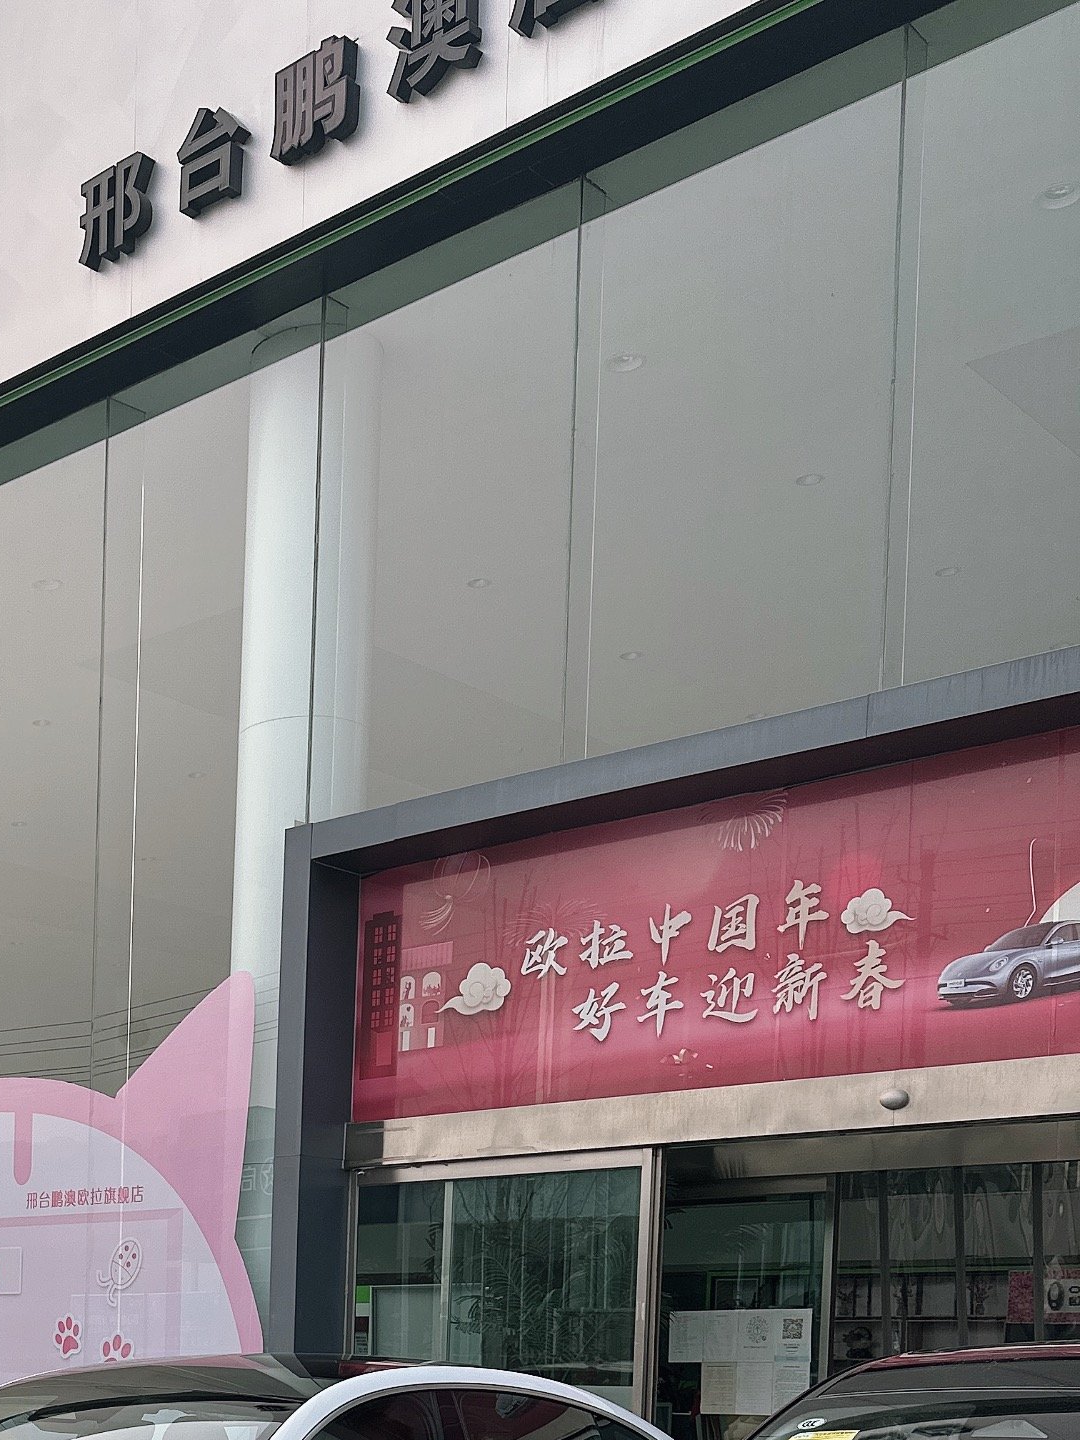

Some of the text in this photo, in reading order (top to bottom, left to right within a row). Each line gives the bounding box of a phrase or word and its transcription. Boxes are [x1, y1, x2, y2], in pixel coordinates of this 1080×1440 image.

[79, 0, 610, 272] 邢台鹏澳
[520, 879, 831, 980] 欧拉中国年
[571, 940, 906, 1042] 好车迎新春
[26, 1185, 144, 1209] 邢台鹏澳欧拉旗舰店
